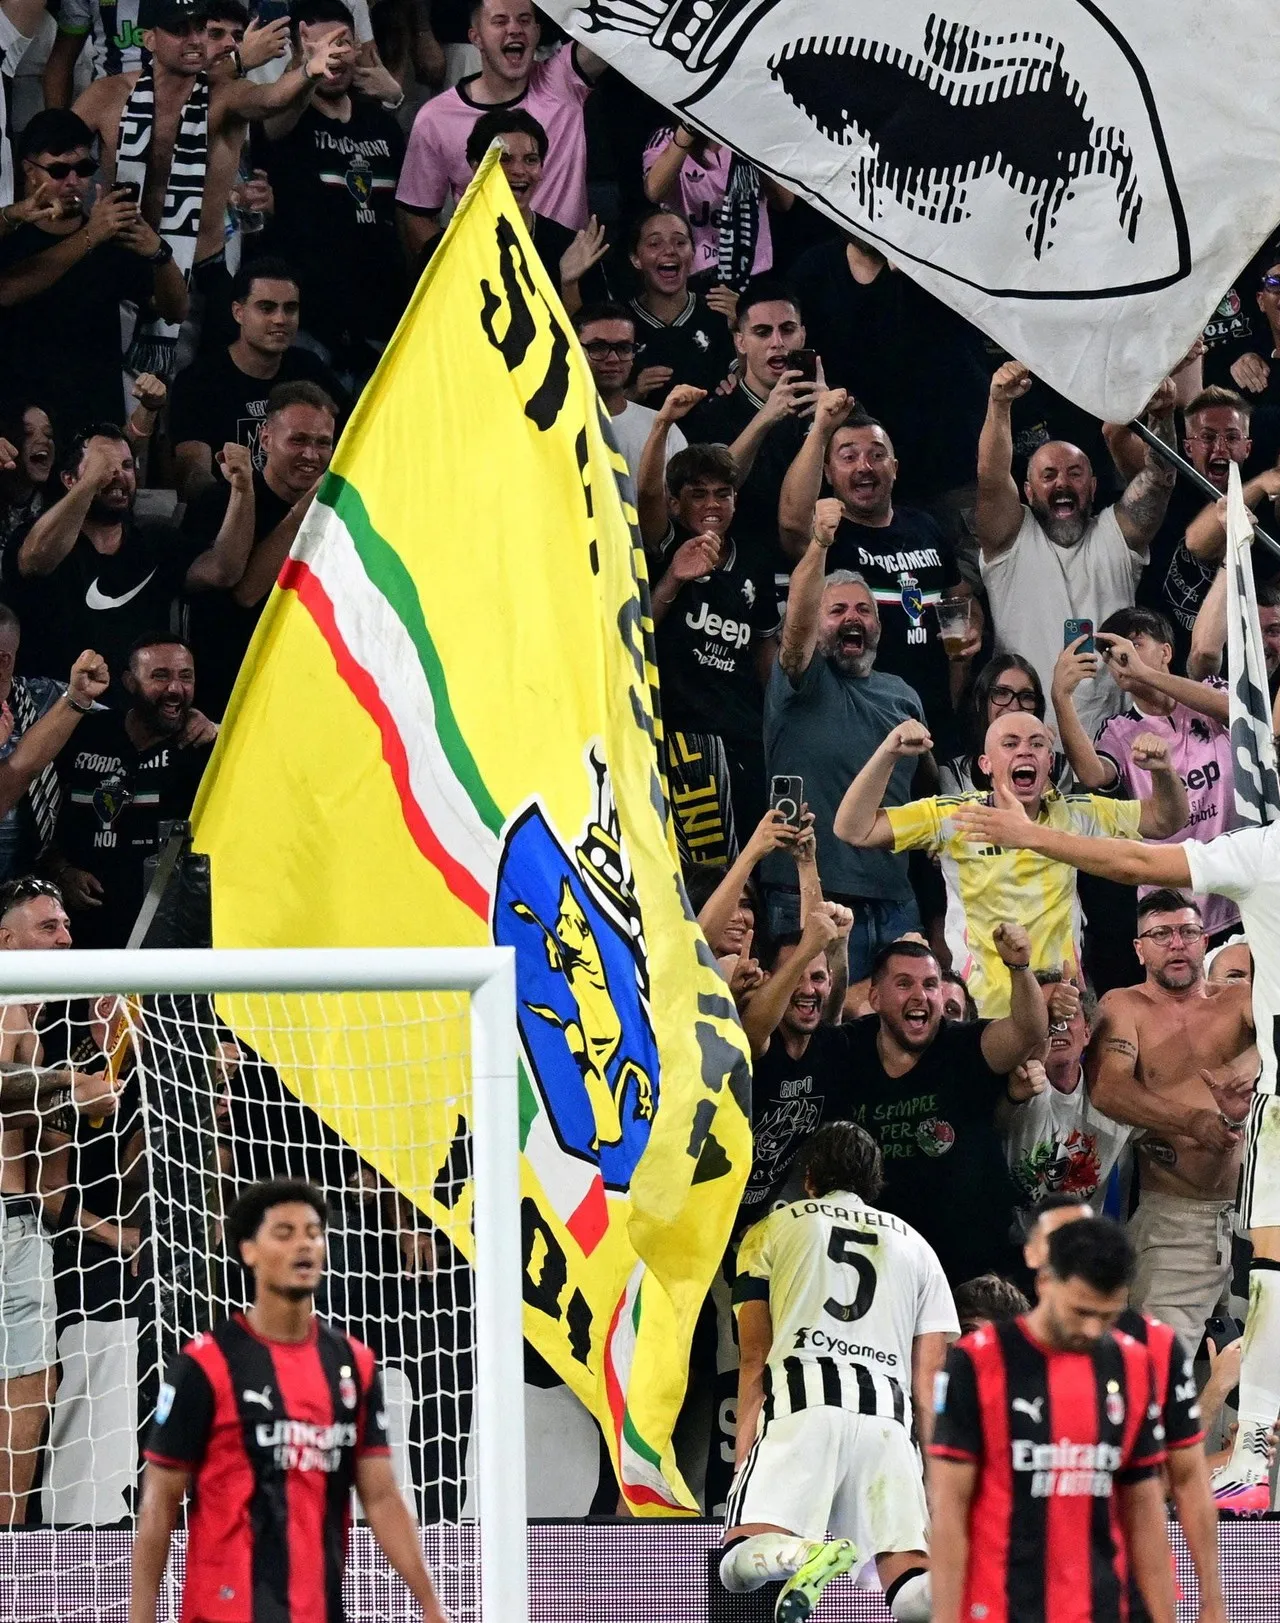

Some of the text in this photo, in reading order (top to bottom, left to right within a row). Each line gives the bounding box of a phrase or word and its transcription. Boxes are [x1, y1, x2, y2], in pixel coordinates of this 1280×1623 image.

[355, 209, 377, 224] NOI
[1203, 318, 1243, 337] OLA
[685, 601, 751, 650] Jeep
[906, 626, 927, 645] NOI
[704, 641, 729, 657] VISIT
[1180, 760, 1221, 791] ep
[1183, 803, 1219, 829] troit
[93, 830, 117, 849] NOI
[881, 1143, 917, 1160] PRE
[791, 1202, 908, 1237] LOCATELLI
[823, 1215, 879, 1323] 5
[811, 1330, 899, 1367] Cygames
